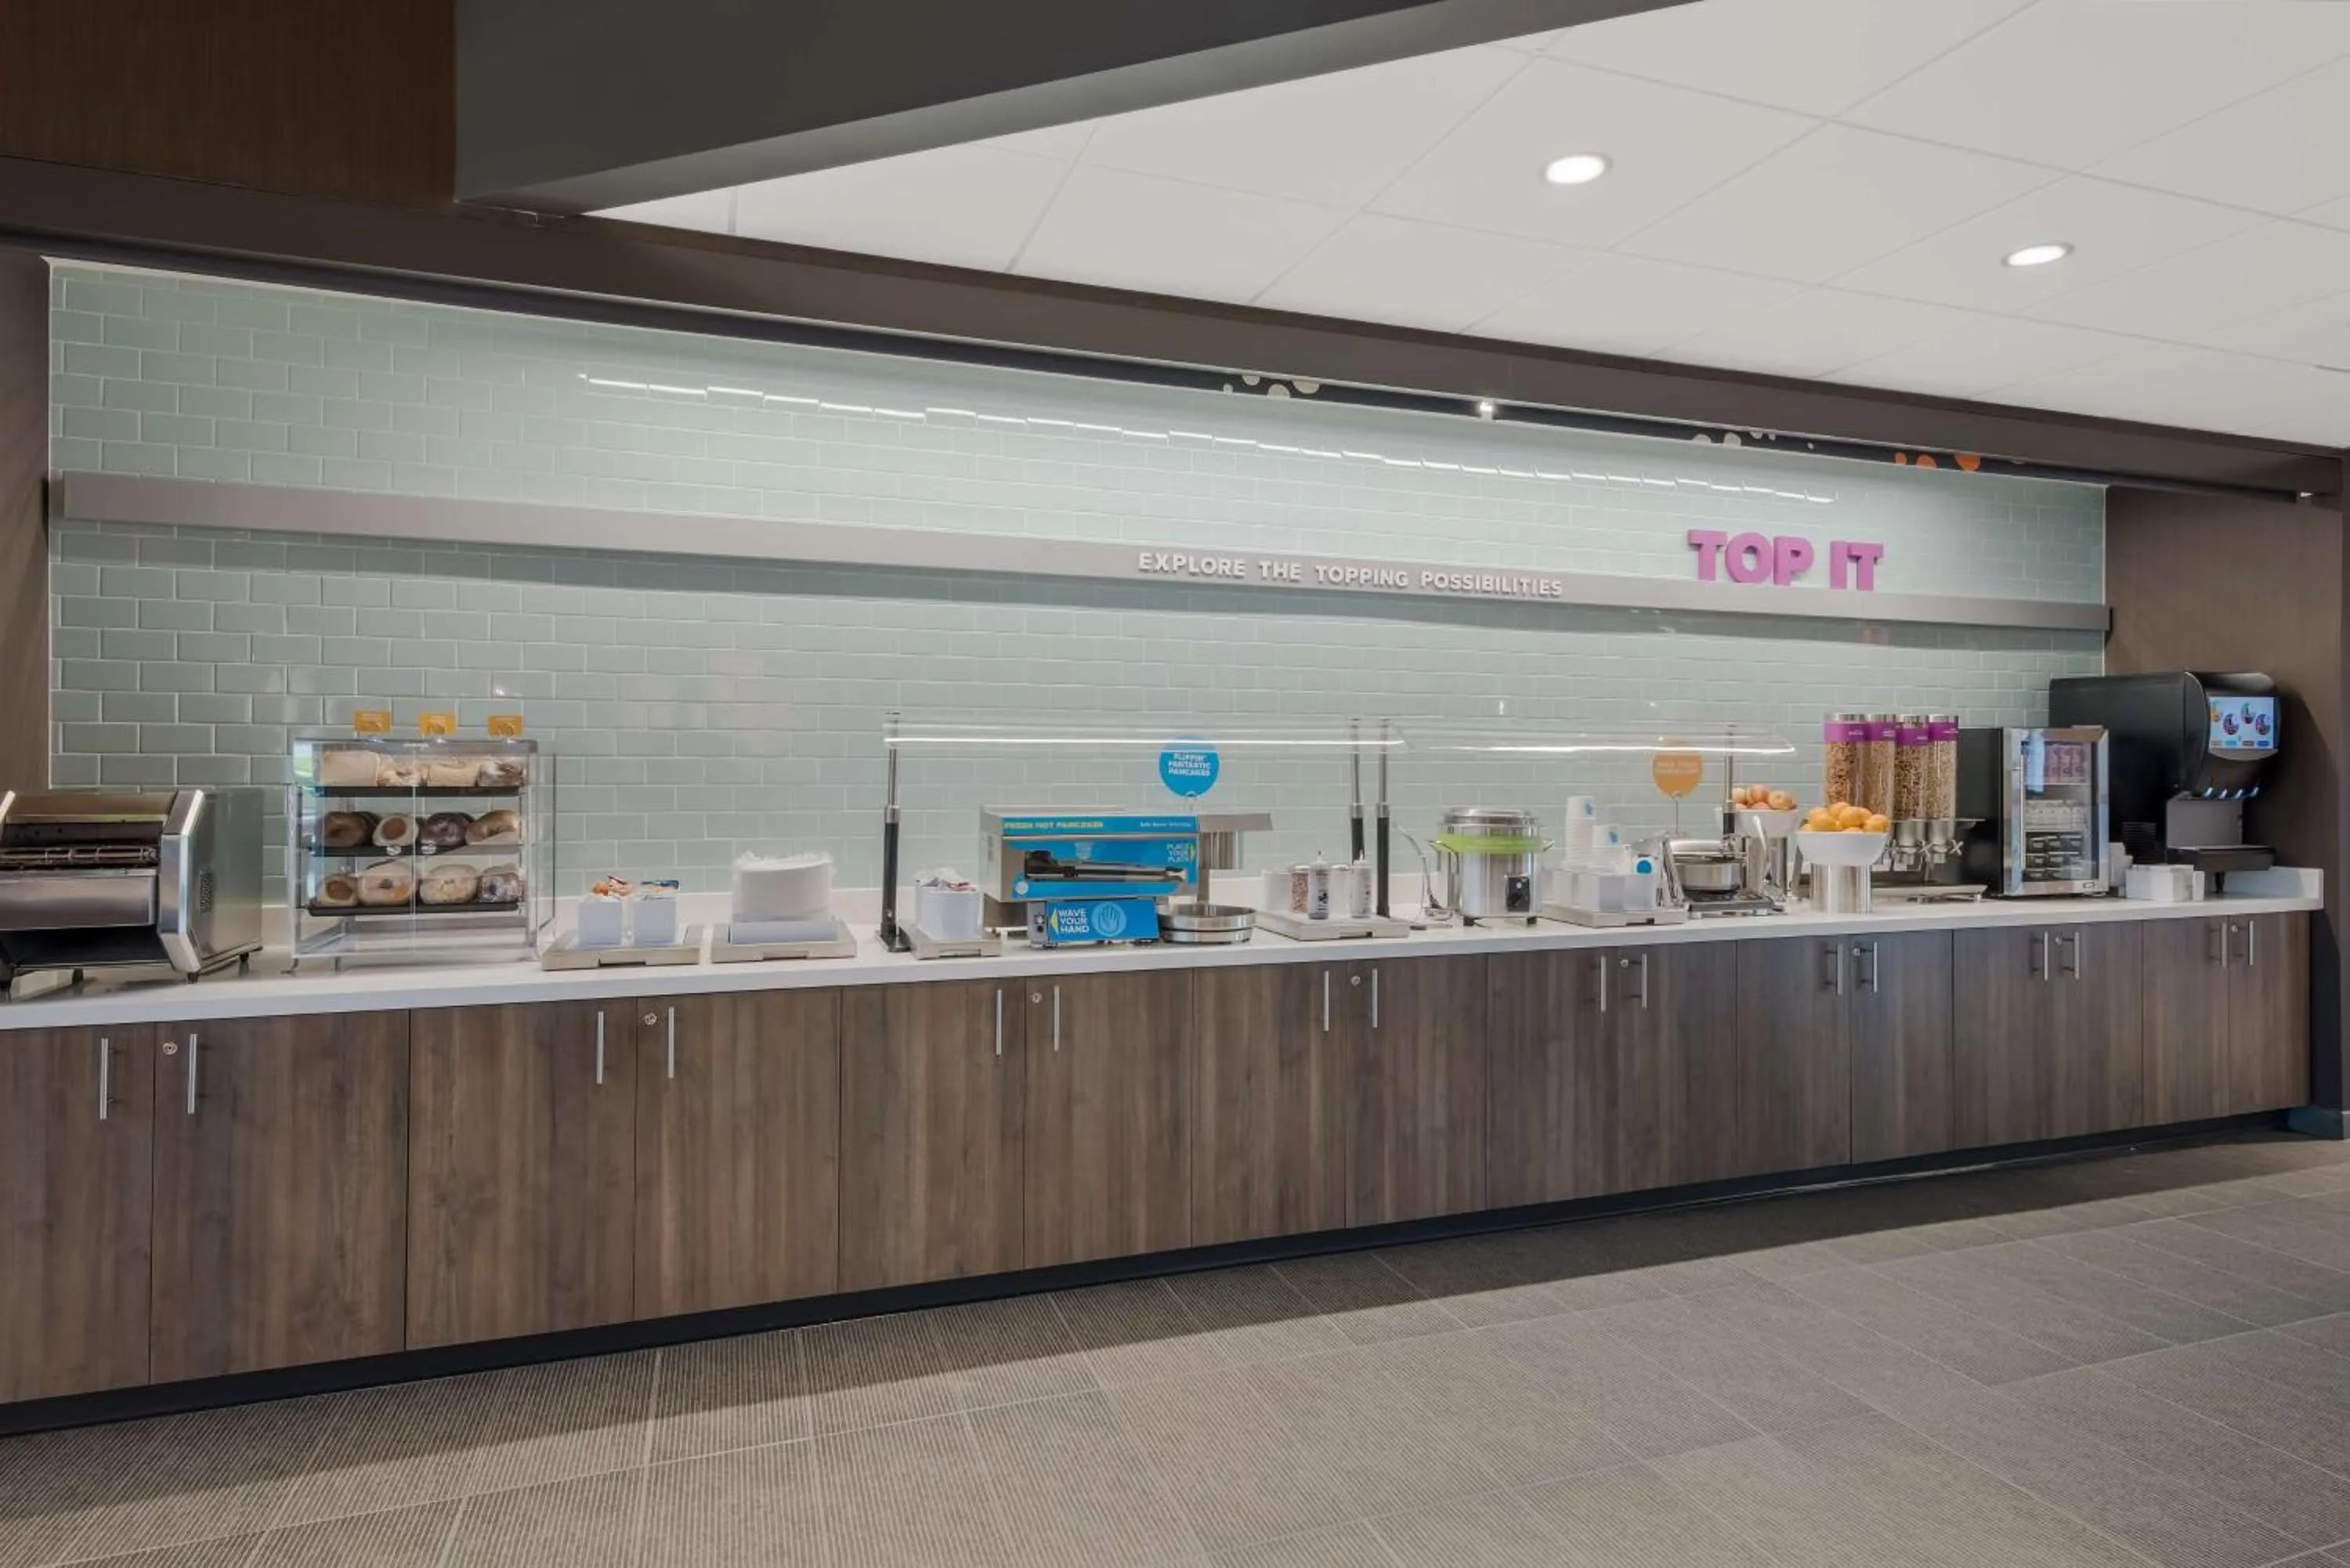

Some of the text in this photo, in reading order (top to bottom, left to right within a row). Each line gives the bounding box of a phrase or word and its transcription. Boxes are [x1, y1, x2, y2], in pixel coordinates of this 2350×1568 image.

[1687, 529, 1884, 591] TOP IT
[1138, 552, 1563, 597] EXPLORE THE TOPPING POSSIBILITIES
[1058, 909, 1086, 917] WAVE
[1060, 925, 1090, 934] HAND
